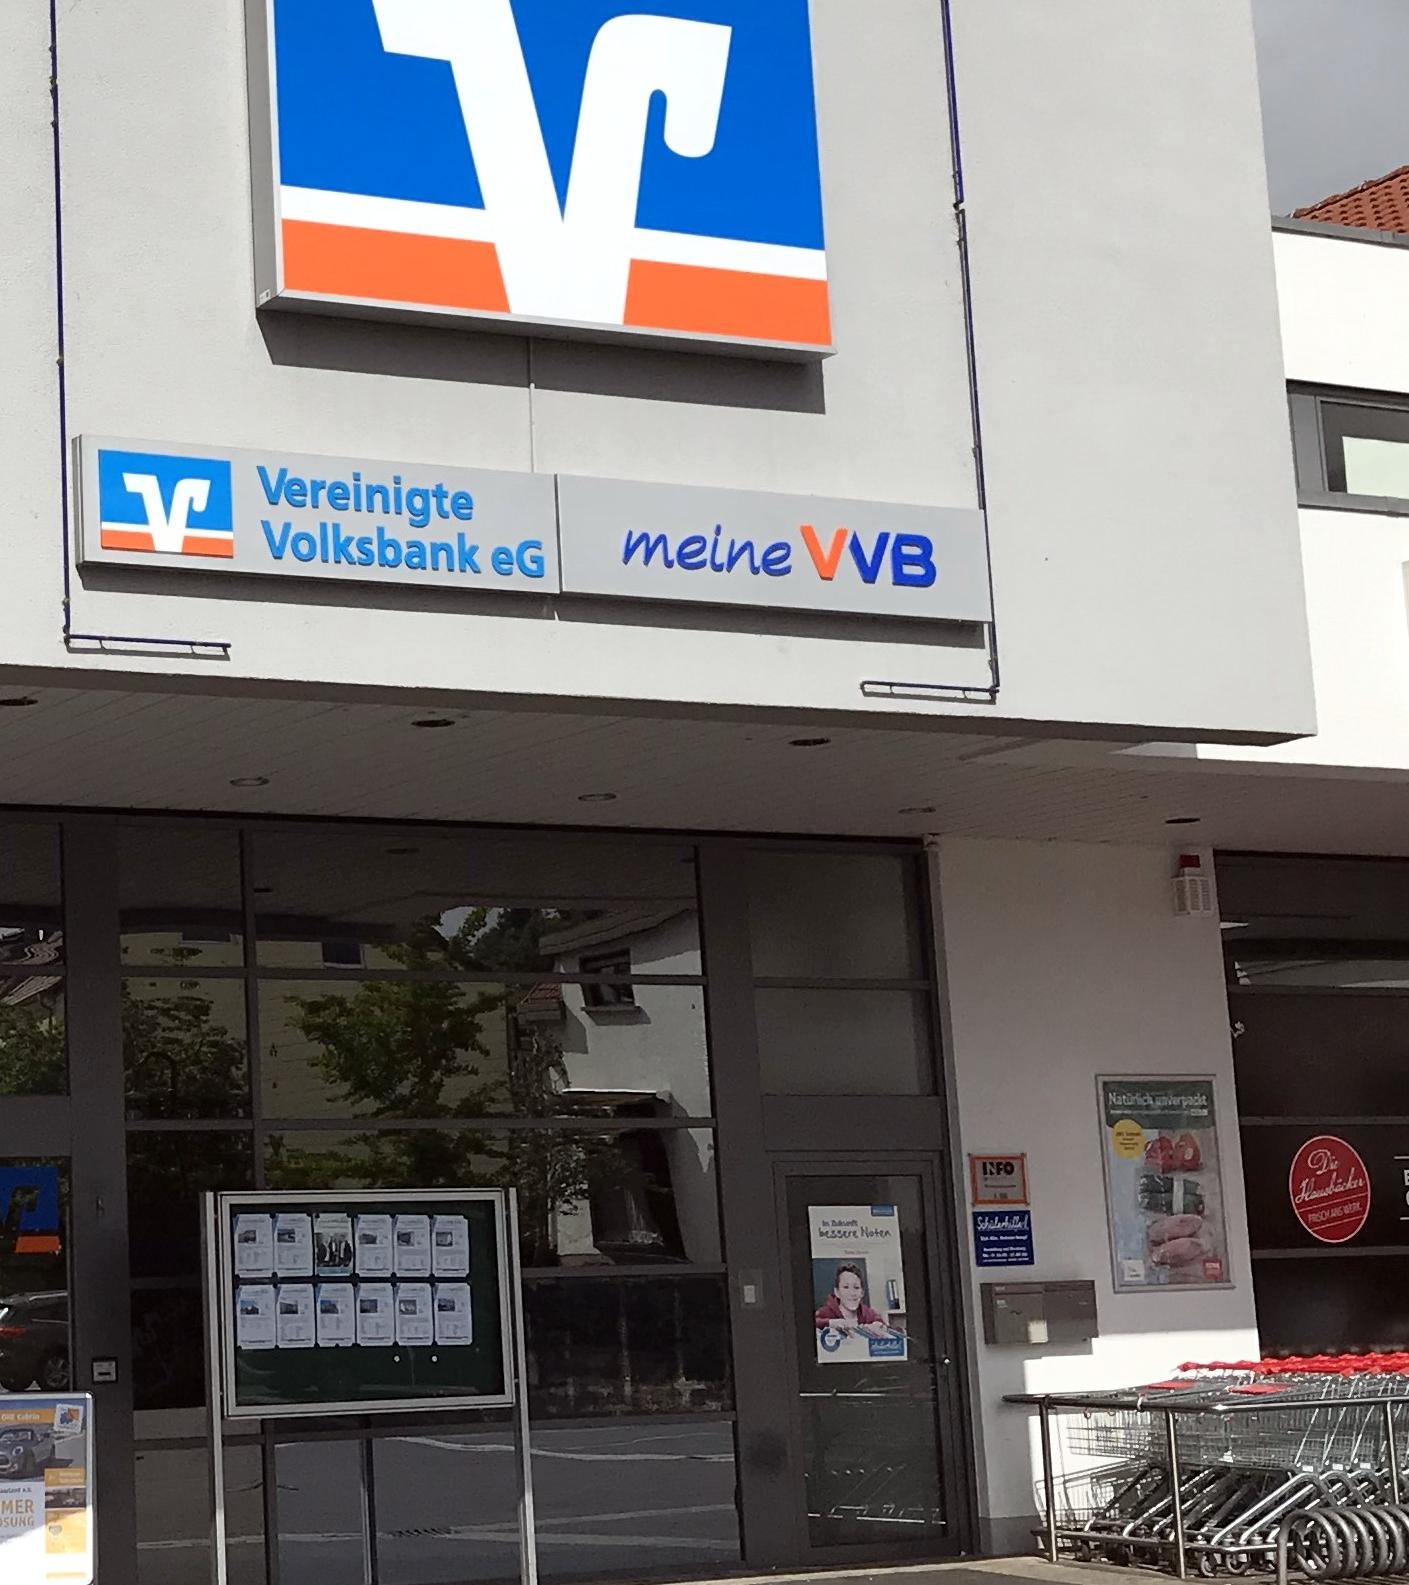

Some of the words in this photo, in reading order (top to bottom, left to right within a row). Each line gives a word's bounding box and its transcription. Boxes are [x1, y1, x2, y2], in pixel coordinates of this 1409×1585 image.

[256, 465, 474, 528] Vereinigte
[260, 519, 482, 574] Volksbank
[491, 540, 545, 578] eG
[622, 523, 792, 577] meine
[799, 525, 937, 588] VVB
[1108, 1092, 1153, 1106] Natürlich
[1295, 1167, 1365, 1204] Hausbäcker
[818, 1227, 859, 1239] bessere
[860, 1226, 892, 1239] Noten
